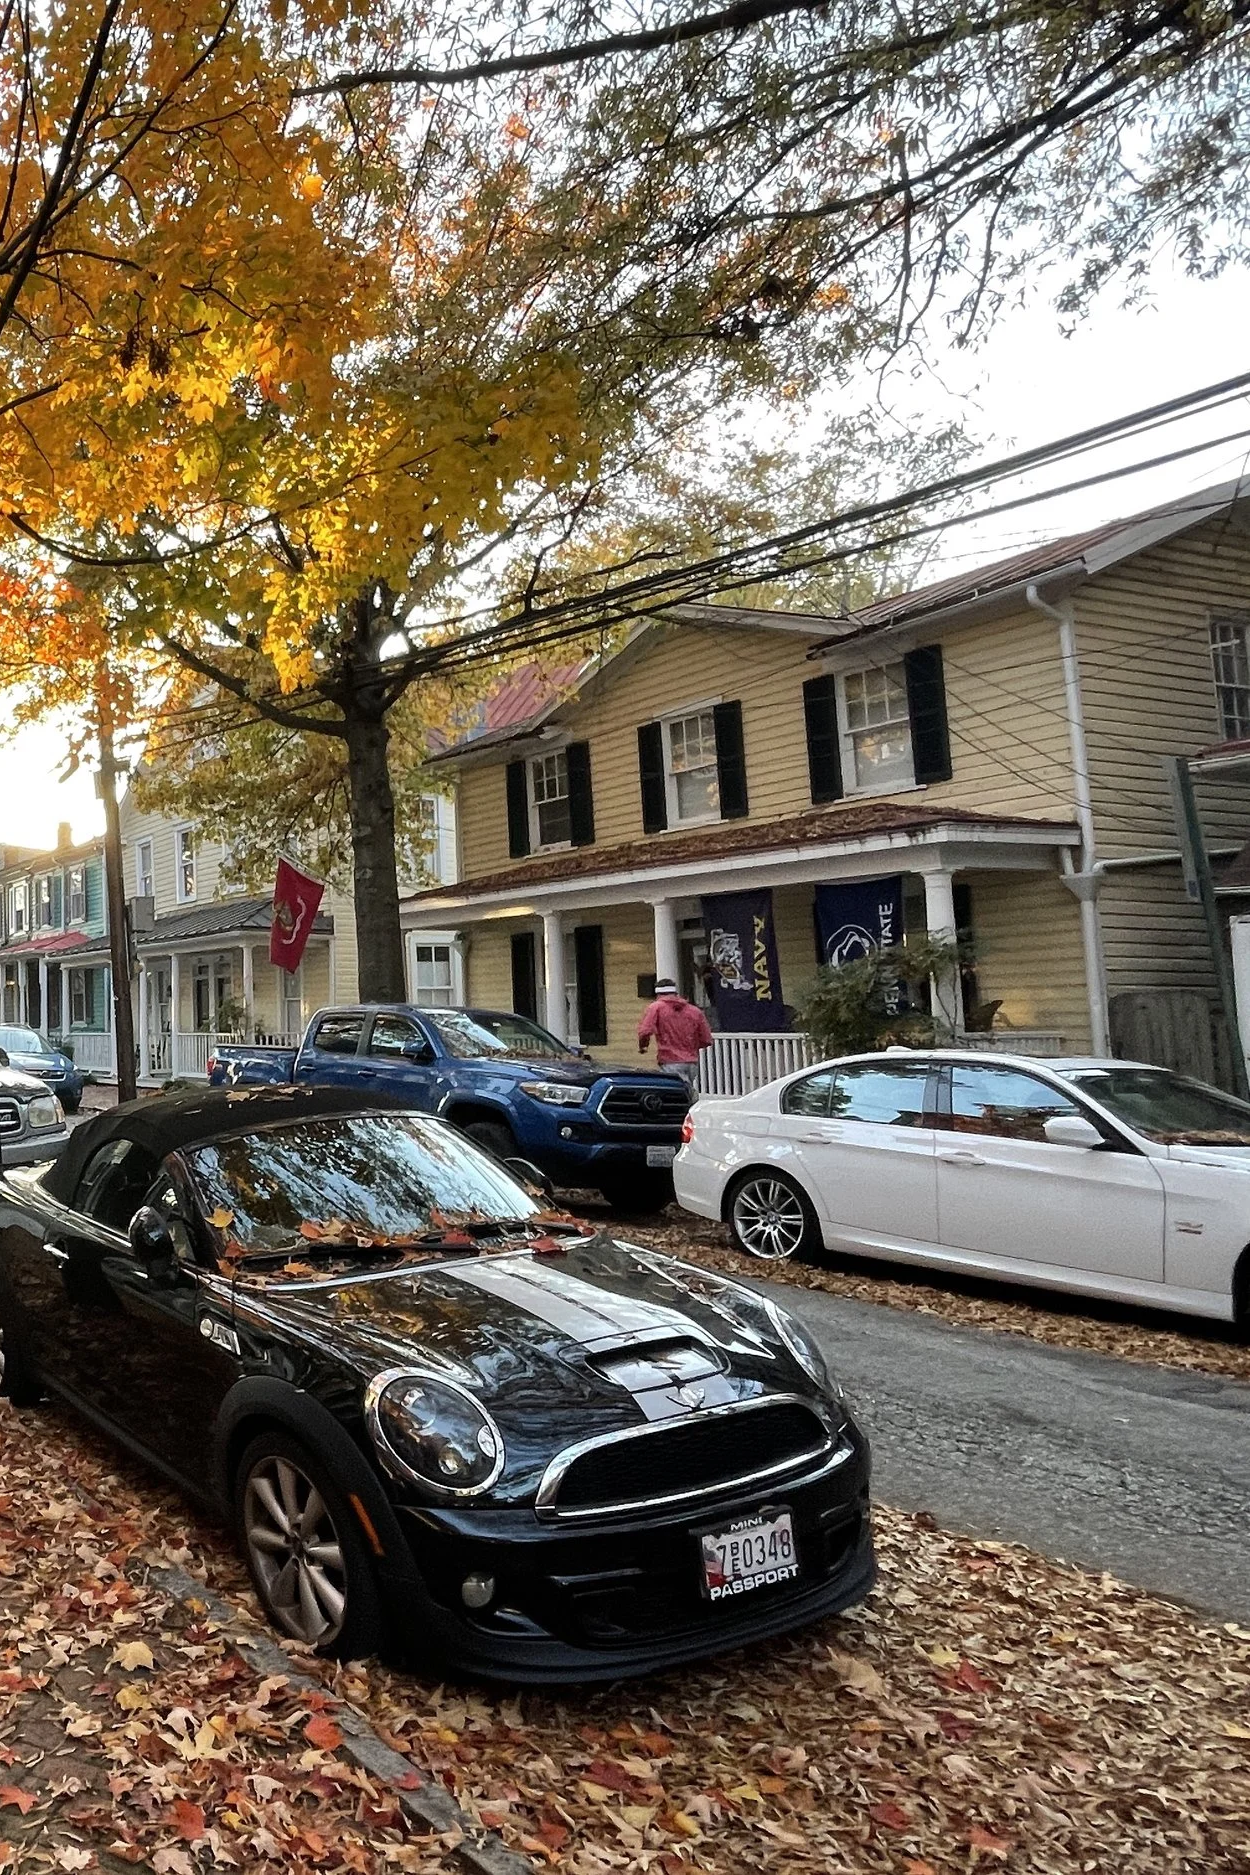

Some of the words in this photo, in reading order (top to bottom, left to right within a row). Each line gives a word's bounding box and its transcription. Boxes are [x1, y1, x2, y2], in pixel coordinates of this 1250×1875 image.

[878, 902, 894, 958] TATE
[753, 915, 772, 1001] NAVY
[730, 1516, 763, 1531] MINI
[710, 1563, 799, 1601] PASSPORT
